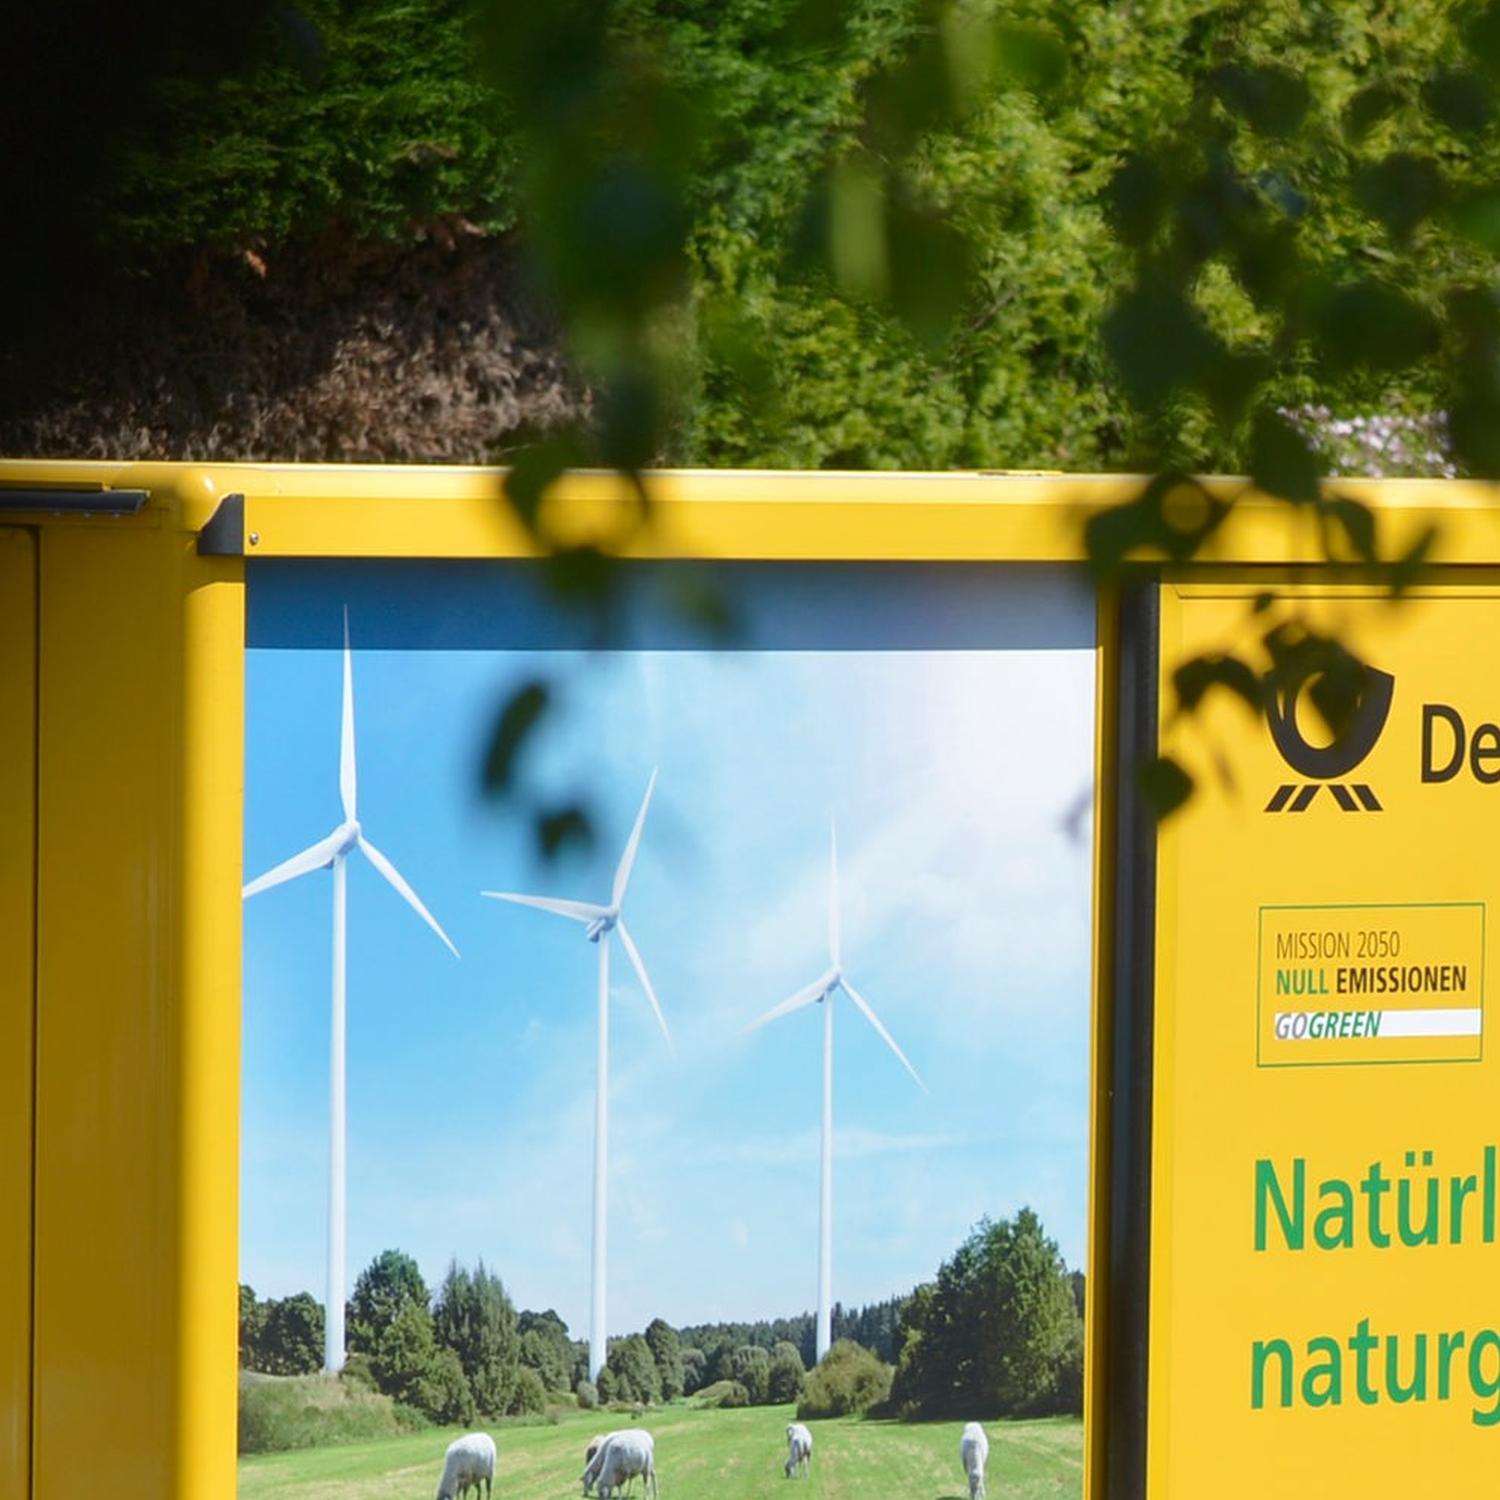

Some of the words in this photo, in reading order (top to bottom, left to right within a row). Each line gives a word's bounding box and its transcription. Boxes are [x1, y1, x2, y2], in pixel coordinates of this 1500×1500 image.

[1276, 931, 1350, 960] MISSION
[1357, 930, 1401, 959] 2050
[1276, 968, 1329, 995] NULL
[1336, 965, 1467, 995] EMISSIONEN
[1275, 1011, 1382, 1040] GOGREEN
